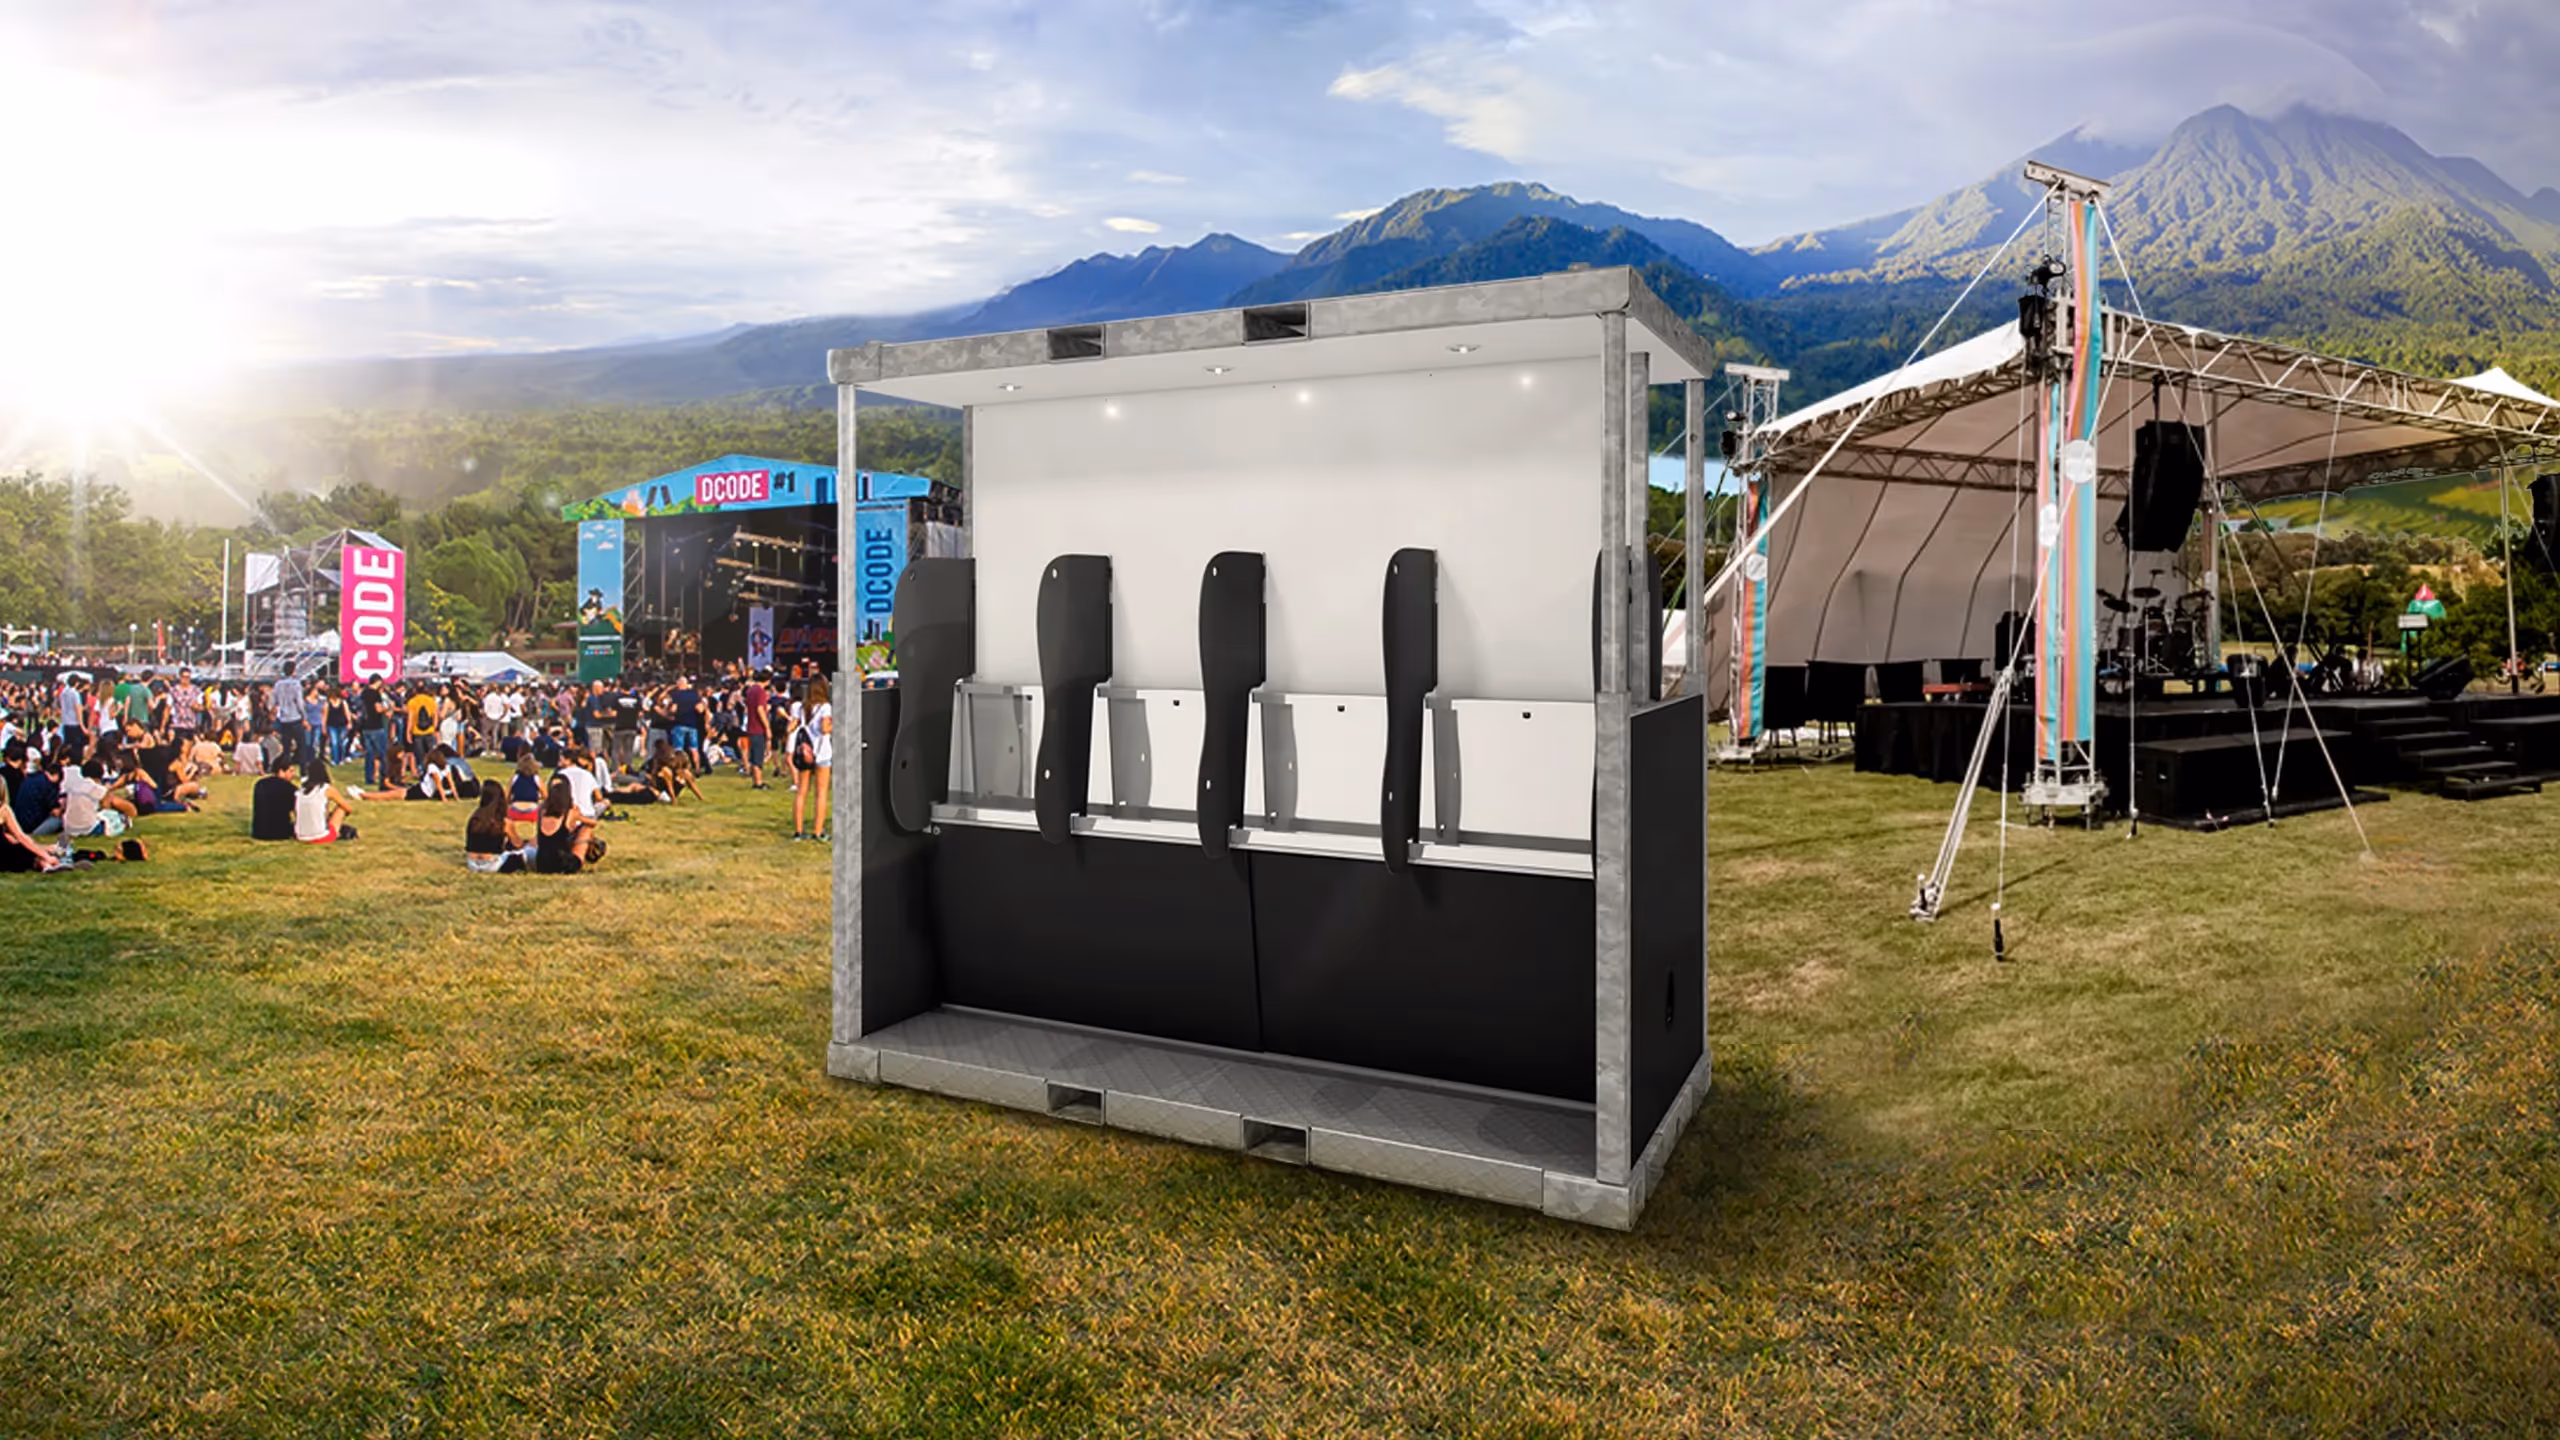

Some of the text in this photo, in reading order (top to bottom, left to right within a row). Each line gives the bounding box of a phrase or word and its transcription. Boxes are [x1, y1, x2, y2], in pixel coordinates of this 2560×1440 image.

[702, 472, 795, 501] DCODE #1
[865, 528, 892, 613] DCODE
[353, 549, 395, 679] CODE
